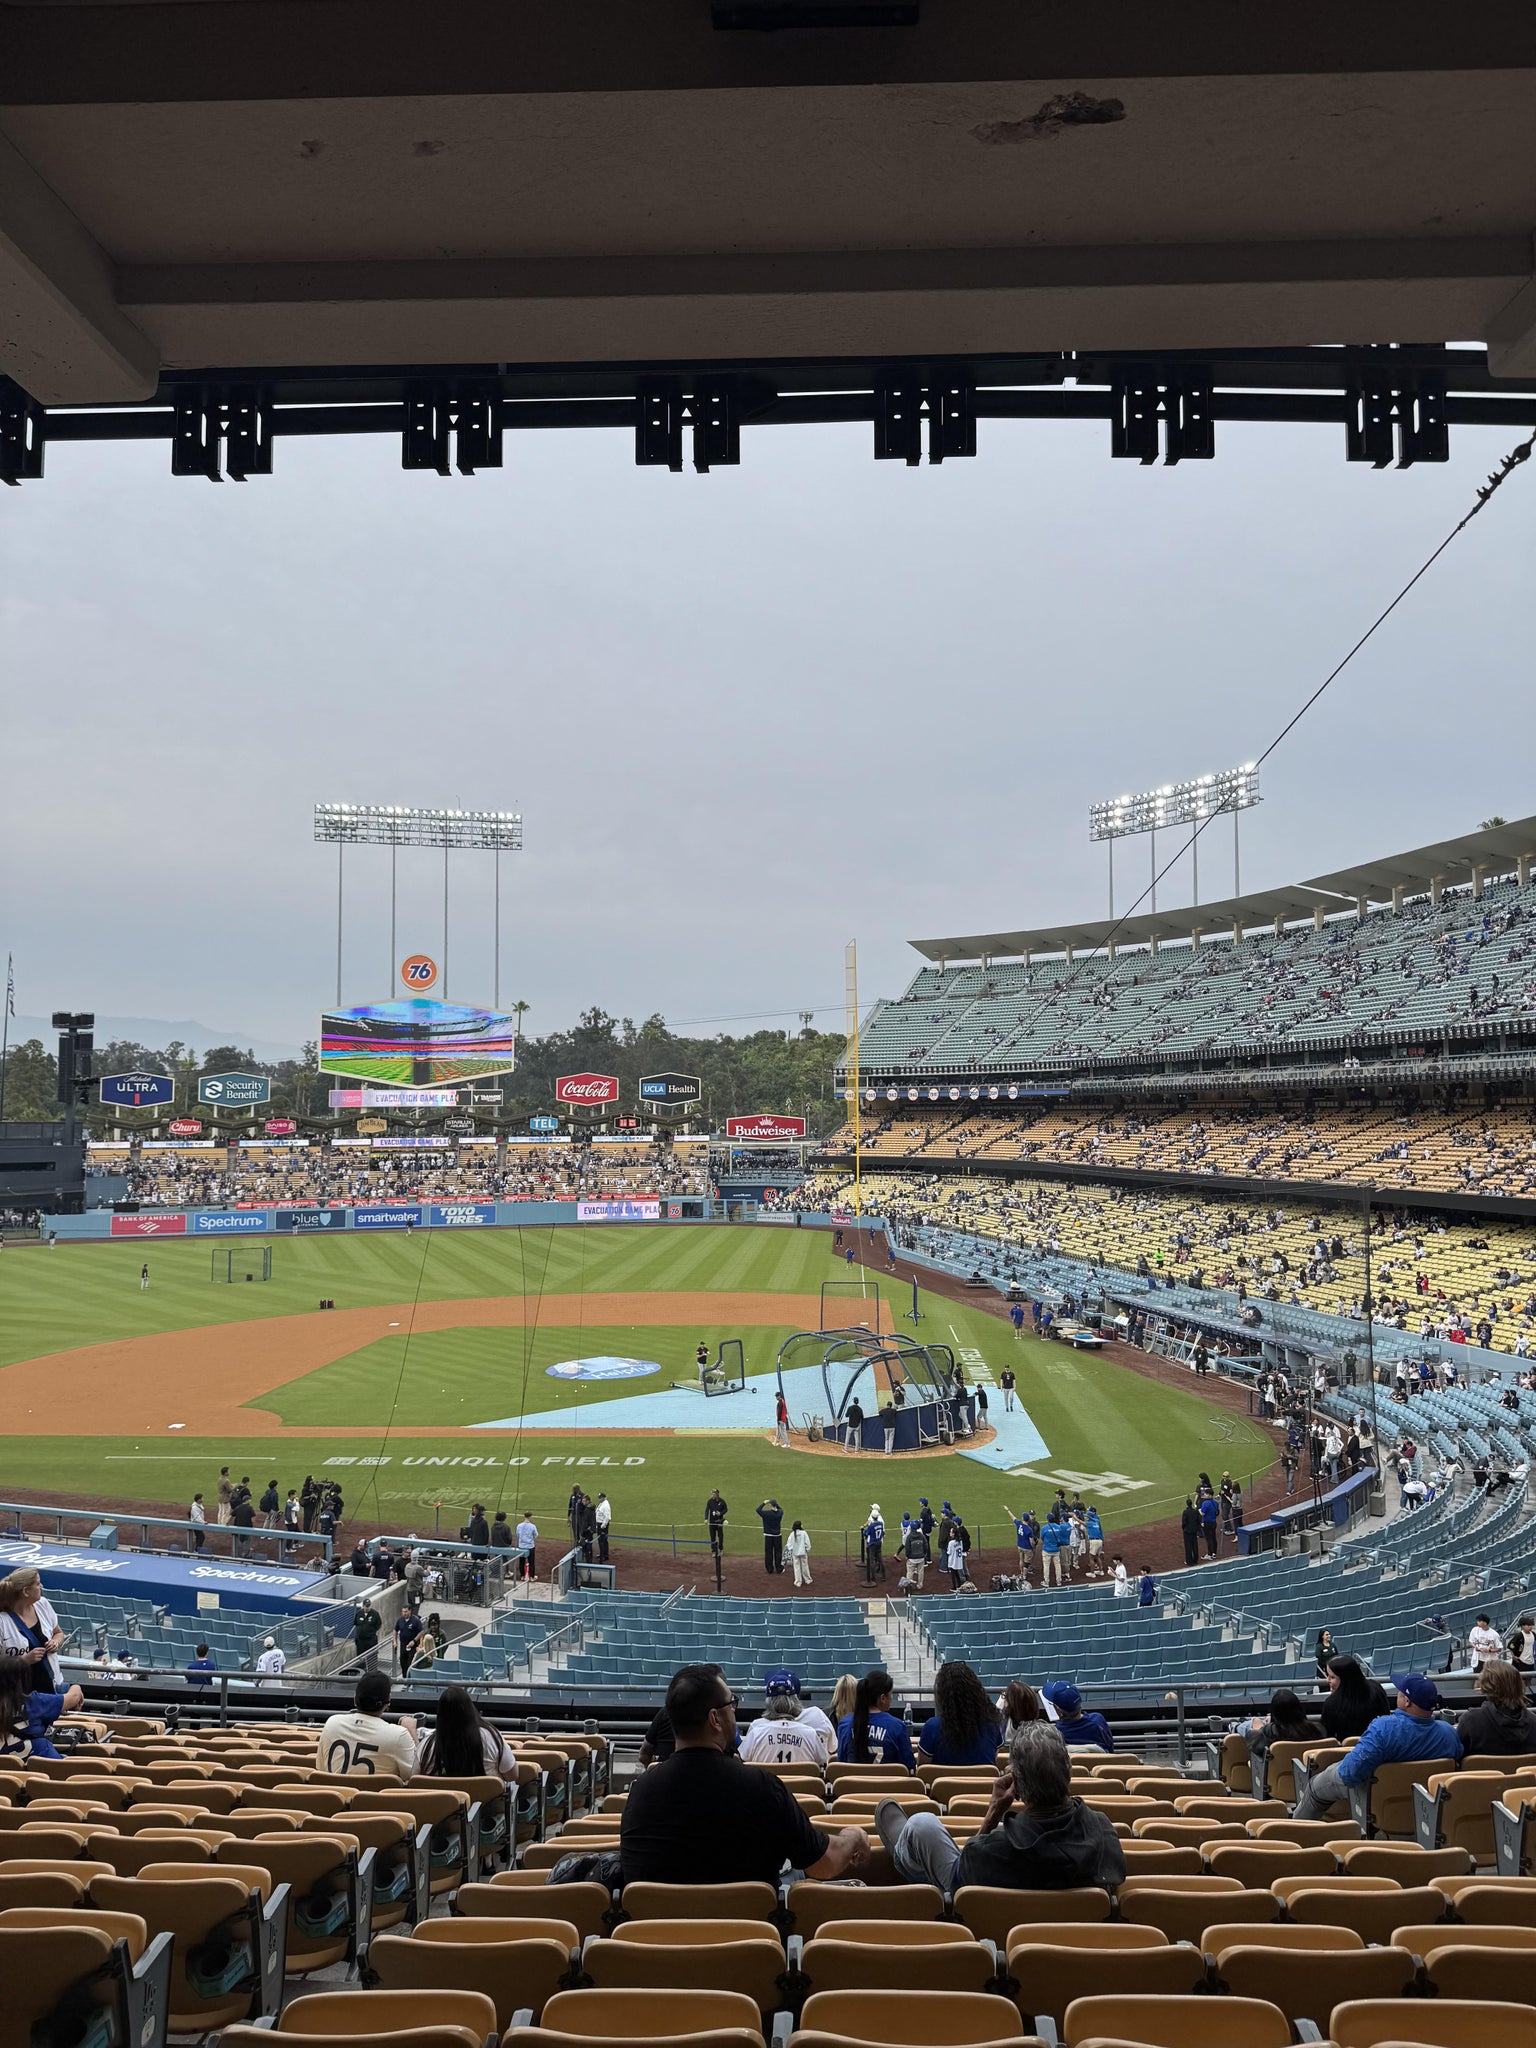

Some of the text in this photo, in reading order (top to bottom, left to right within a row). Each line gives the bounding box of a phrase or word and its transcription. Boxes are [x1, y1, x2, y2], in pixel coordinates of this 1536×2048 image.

[408, 961, 432, 981] 76
[117, 1083, 158, 1092] ULTRA
[226, 1081, 264, 1092] Security
[561, 1080, 612, 1098] Coca-Cola
[643, 1084, 696, 1094] UCLA Health
[226, 1090, 259, 1099] Benefit
[375, 1094, 417, 1103] EVACUATION
[419, 1094, 438, 1103] GAME
[171, 1123, 200, 1132] Churu
[533, 1119, 555, 1128] TEL
[735, 1125, 798, 1136] Budweiser
[766, 1190, 776, 1198] 76
[439, 1206, 476, 1216] TOYO
[584, 1206, 623, 1215] EVACUATION
[625, 1205, 643, 1214] GAME
[199, 1216, 257, 1230] Spectrum
[292, 1213, 319, 1223] blue
[357, 1212, 419, 1223] smartwater
[445, 1214, 484, 1224] TIRES
[402, 1456, 531, 1467] UNIQLO
[541, 1456, 647, 1466] FIELD
[1002, 1467, 1157, 1498] LA
[0, 1541, 131, 1571] Dodgers
[189, 1566, 294, 1585] Spectrum
[273, 1660, 279, 1673] 5
[768, 1733, 803, 1748] R. SASAKI
[327, 1739, 379, 1775] 05
[777, 1750, 792, 1763] 11
